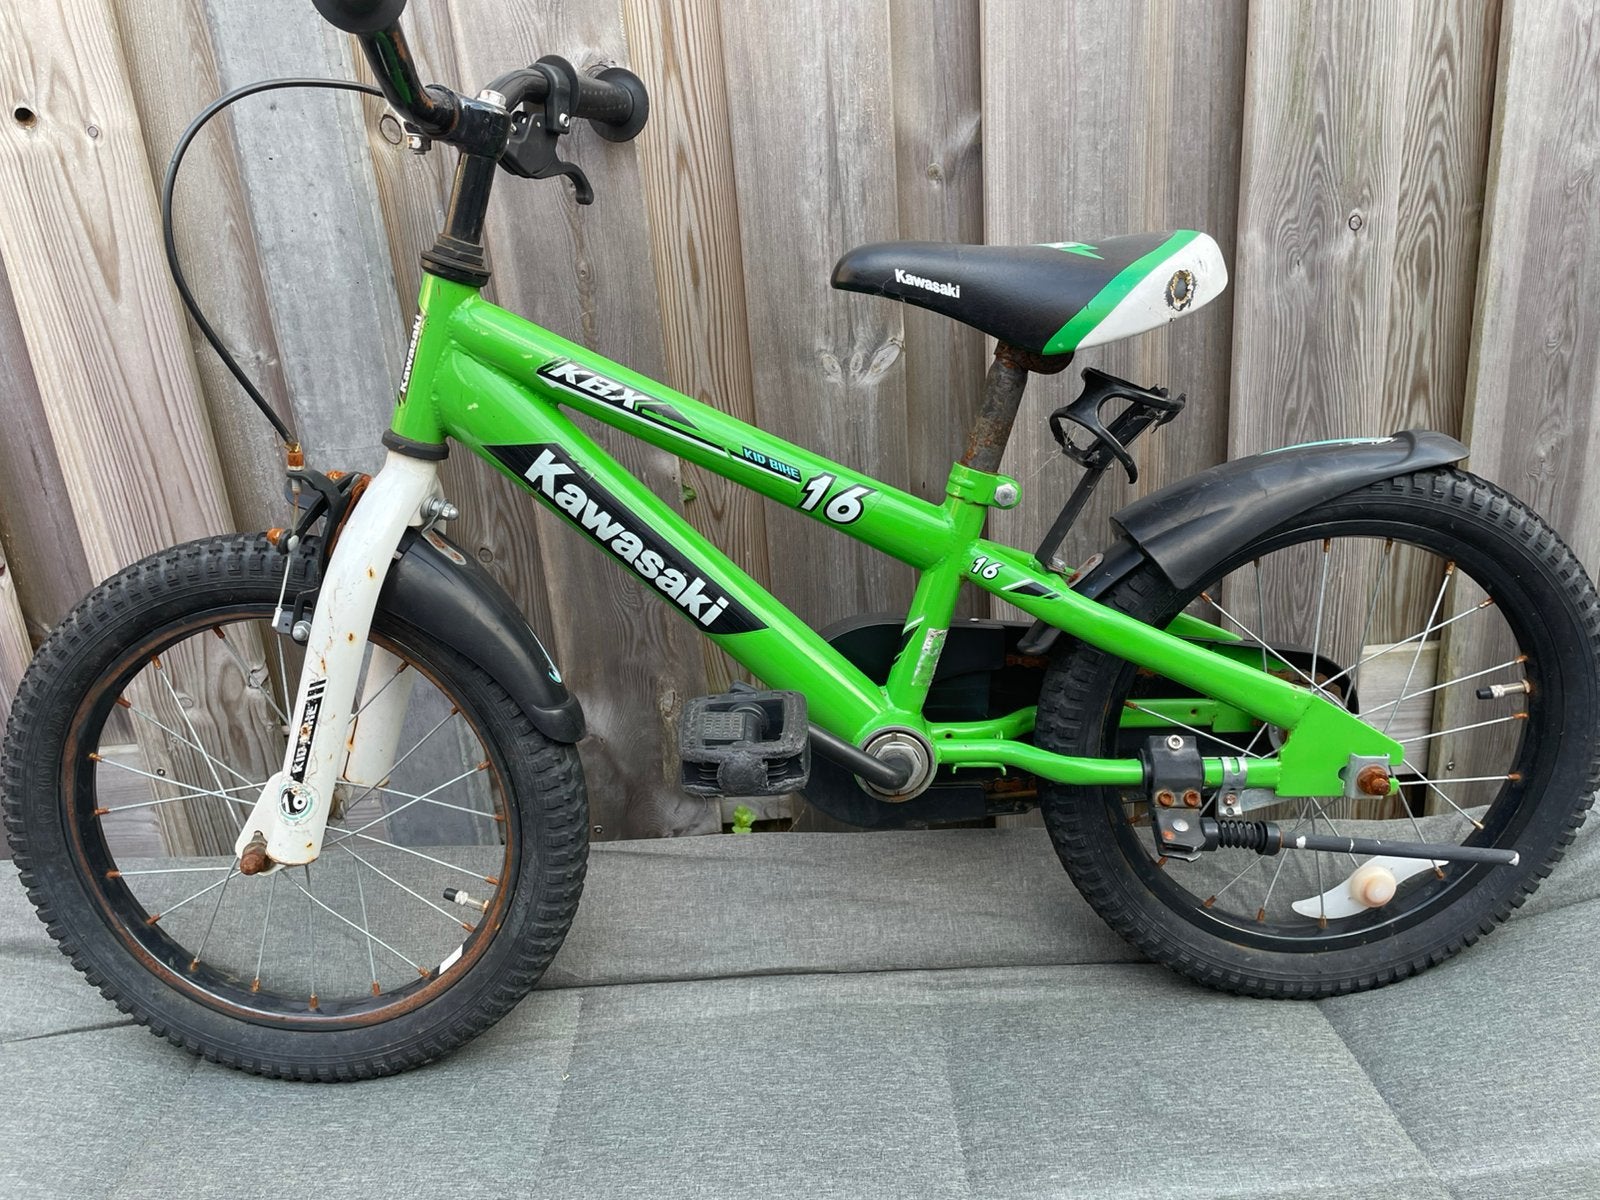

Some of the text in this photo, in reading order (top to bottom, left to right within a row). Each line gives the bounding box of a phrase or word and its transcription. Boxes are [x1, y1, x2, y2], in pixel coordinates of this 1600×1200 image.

[894, 268, 961, 299] Kawasaki
[399, 313, 423, 394] Kawasaki
[550, 363, 648, 409] KBX
[743, 448, 766, 465] KID
[800, 472, 878, 525] 16
[524, 448, 730, 627] Kawasaki
[970, 556, 1005, 580] 16
[292, 745, 307, 773] KID
